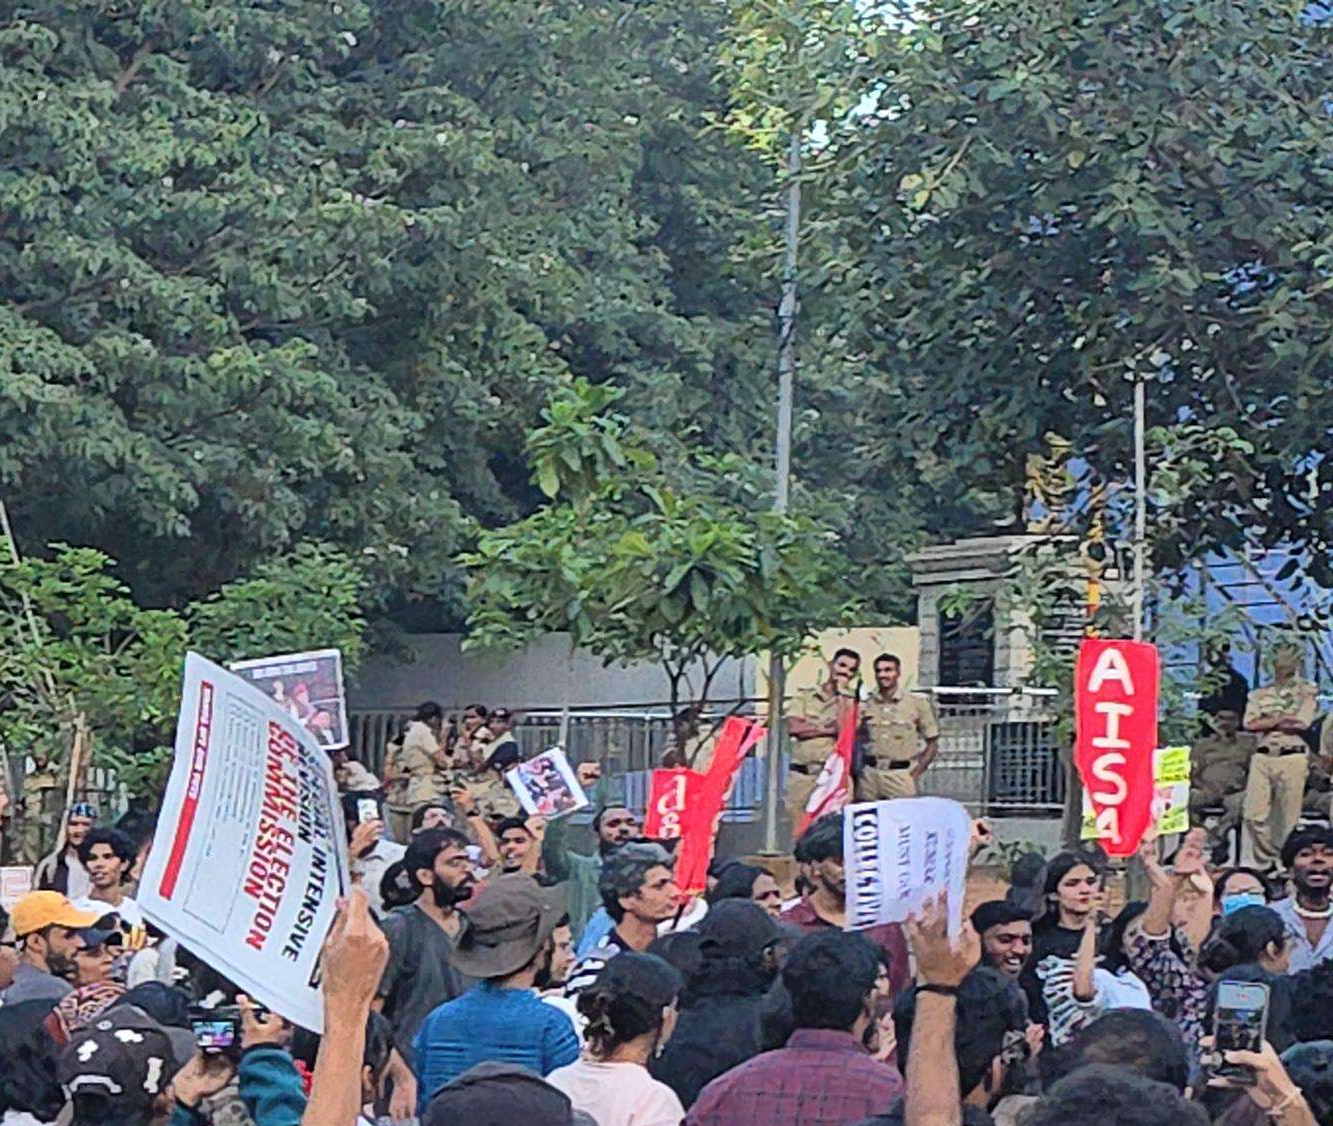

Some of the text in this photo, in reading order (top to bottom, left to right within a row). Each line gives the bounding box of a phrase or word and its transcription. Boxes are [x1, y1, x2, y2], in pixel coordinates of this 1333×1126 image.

[242, 720, 284, 900] COMMISSION
[1087, 647, 1135, 845] AISA
[244, 826, 295, 952] ELECTION
[281, 846, 327, 963] INTENSIVE
